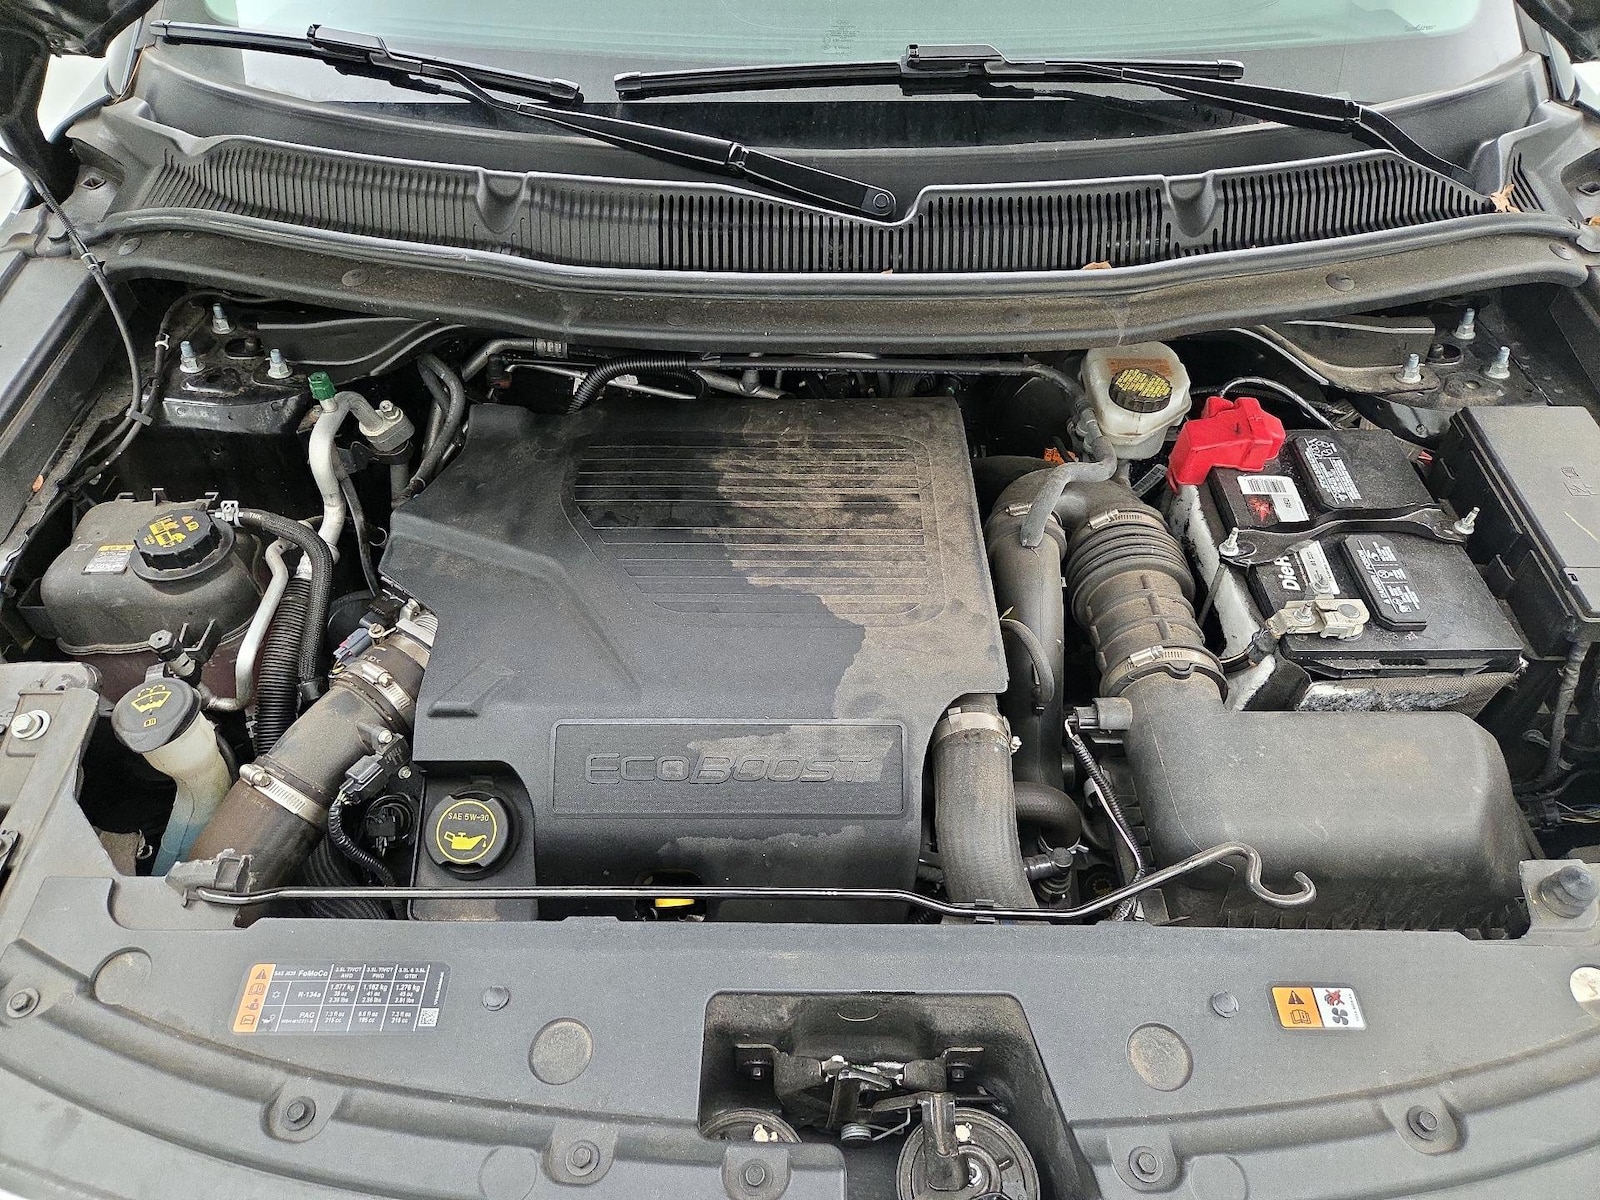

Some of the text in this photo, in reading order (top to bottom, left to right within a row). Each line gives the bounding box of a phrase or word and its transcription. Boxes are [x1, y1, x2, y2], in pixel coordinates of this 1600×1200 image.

[1273, 555, 1301, 591] DieH
[448, 812, 490, 822] SAE 5W-30
[298, 969, 328, 977] FoMoCo
[412, 984, 421, 992] kg
